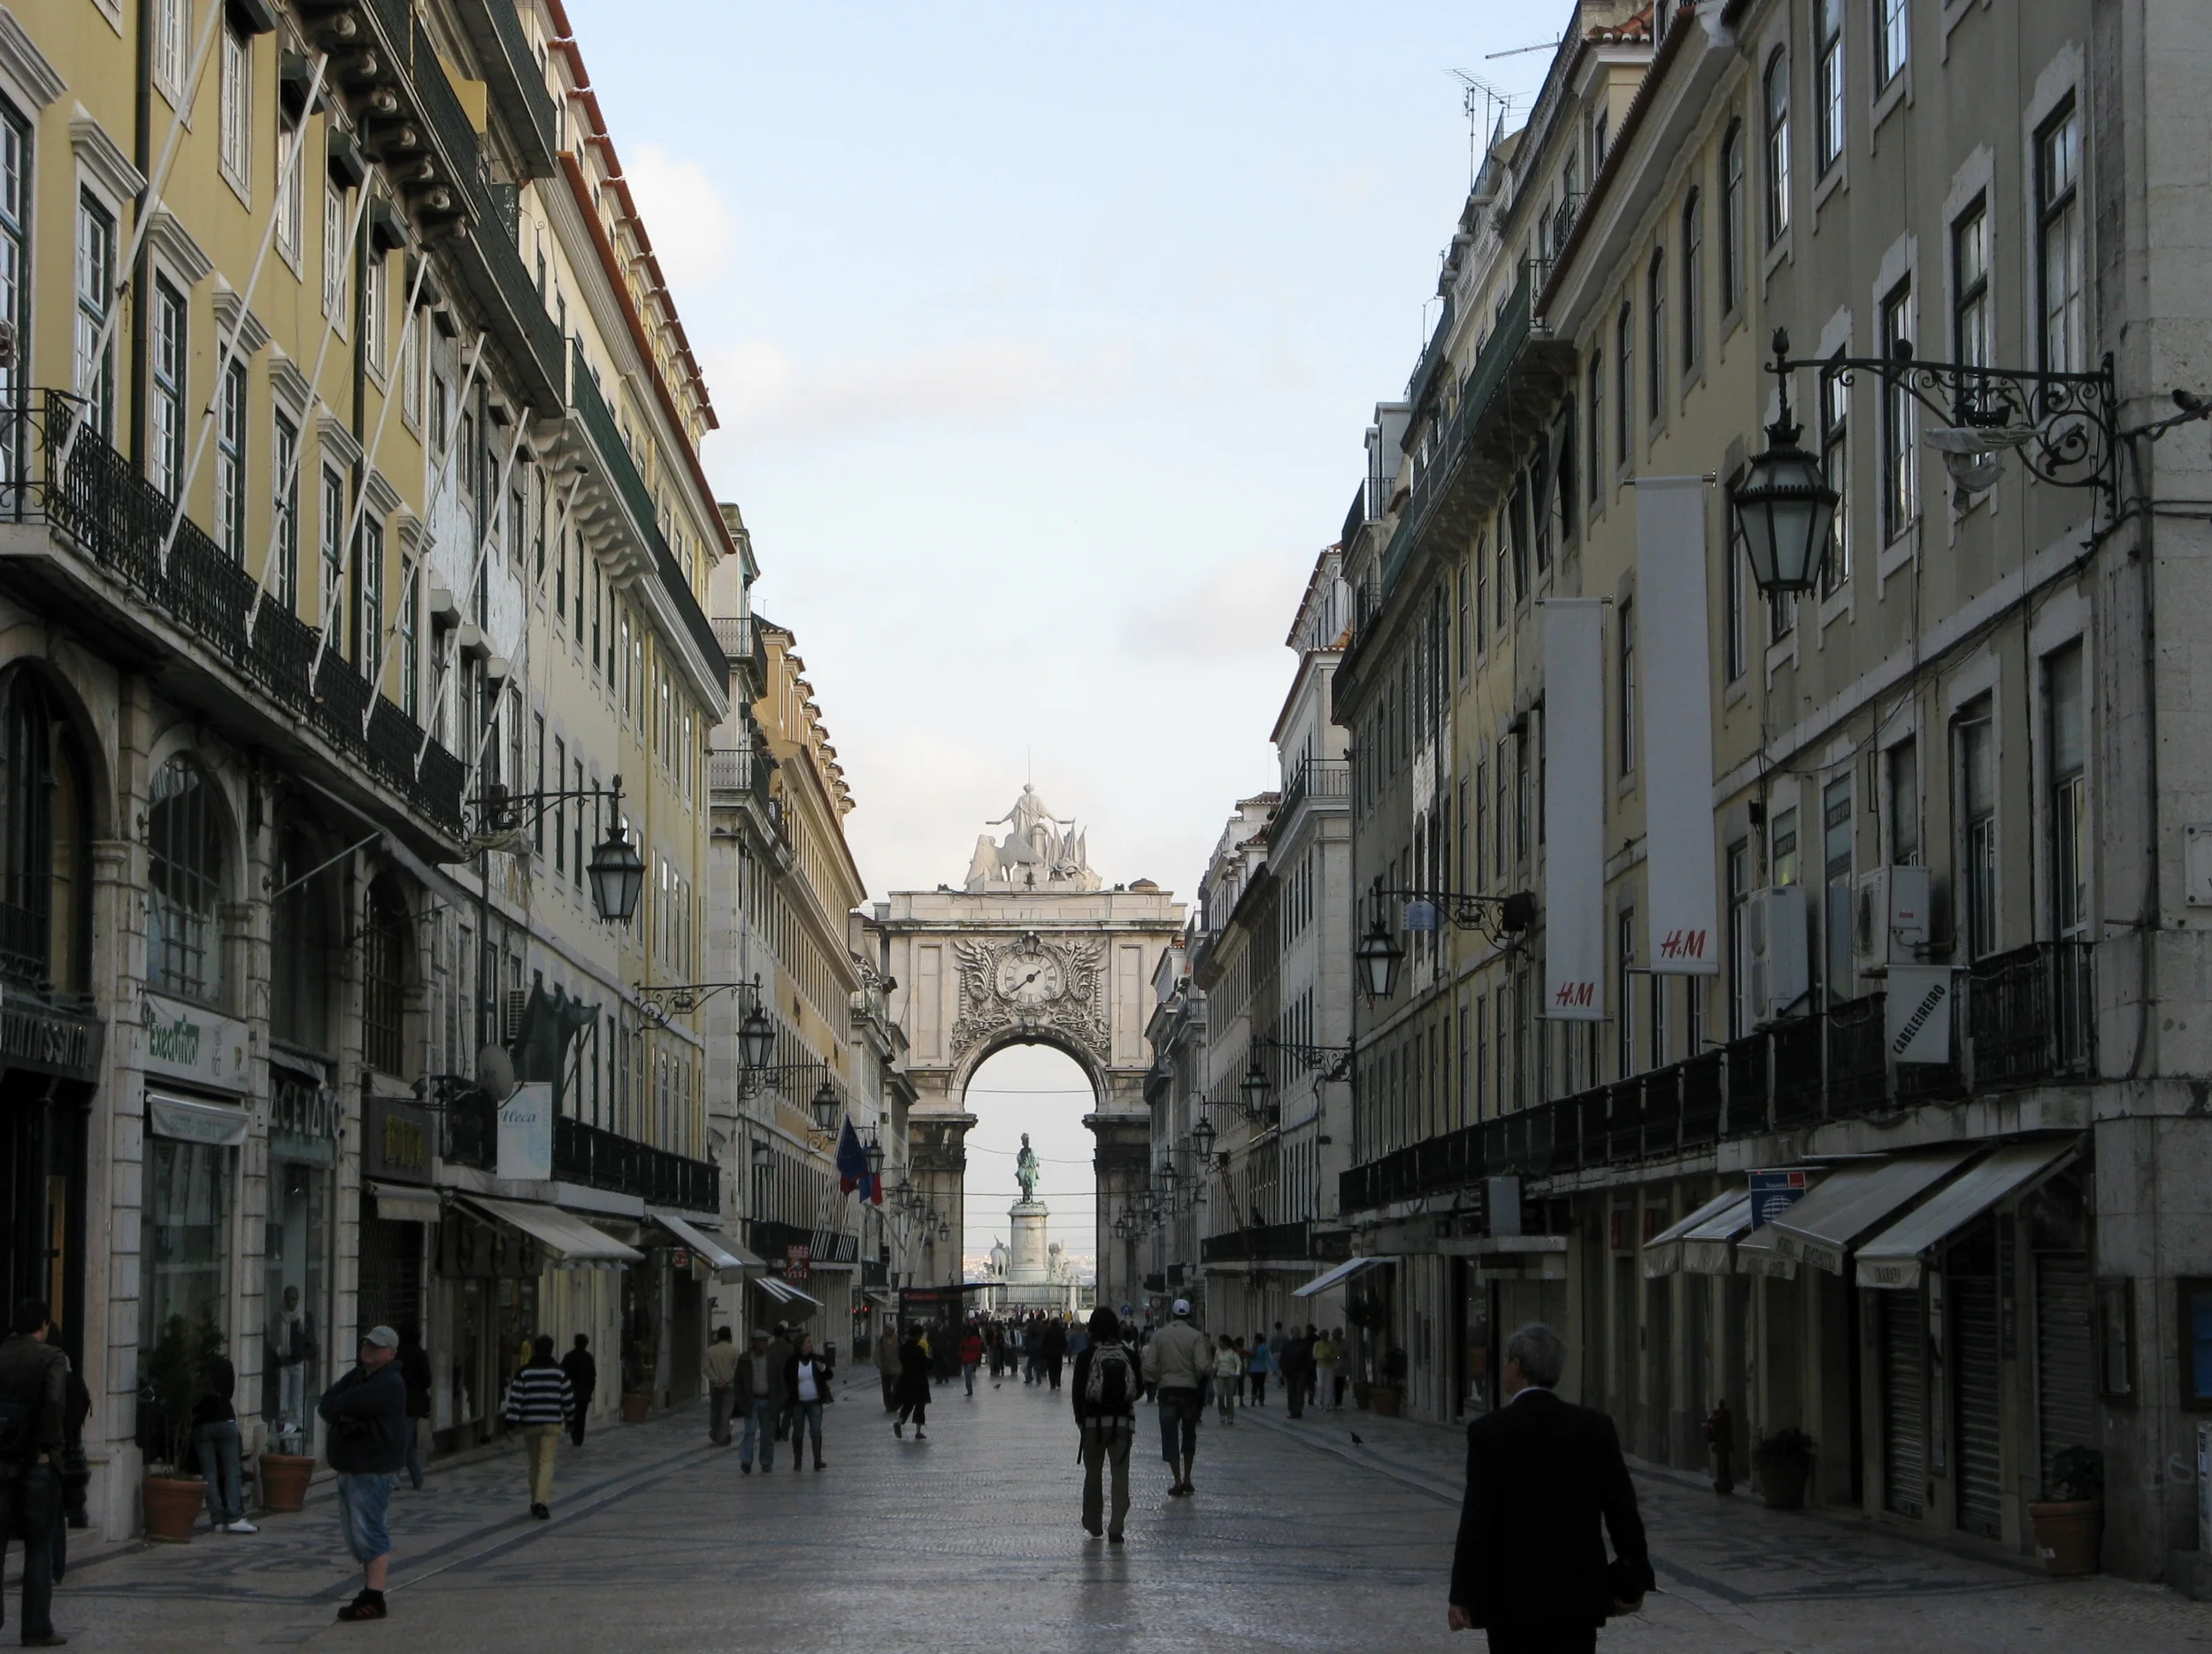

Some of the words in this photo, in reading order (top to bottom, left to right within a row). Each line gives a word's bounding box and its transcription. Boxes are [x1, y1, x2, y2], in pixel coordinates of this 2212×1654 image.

[1661, 929, 1706, 959] H&M
[1556, 982, 1594, 1007] H&M
[1892, 984, 1946, 1054] CABELEIREIRO
[267, 1078, 341, 1141] ACETATO
